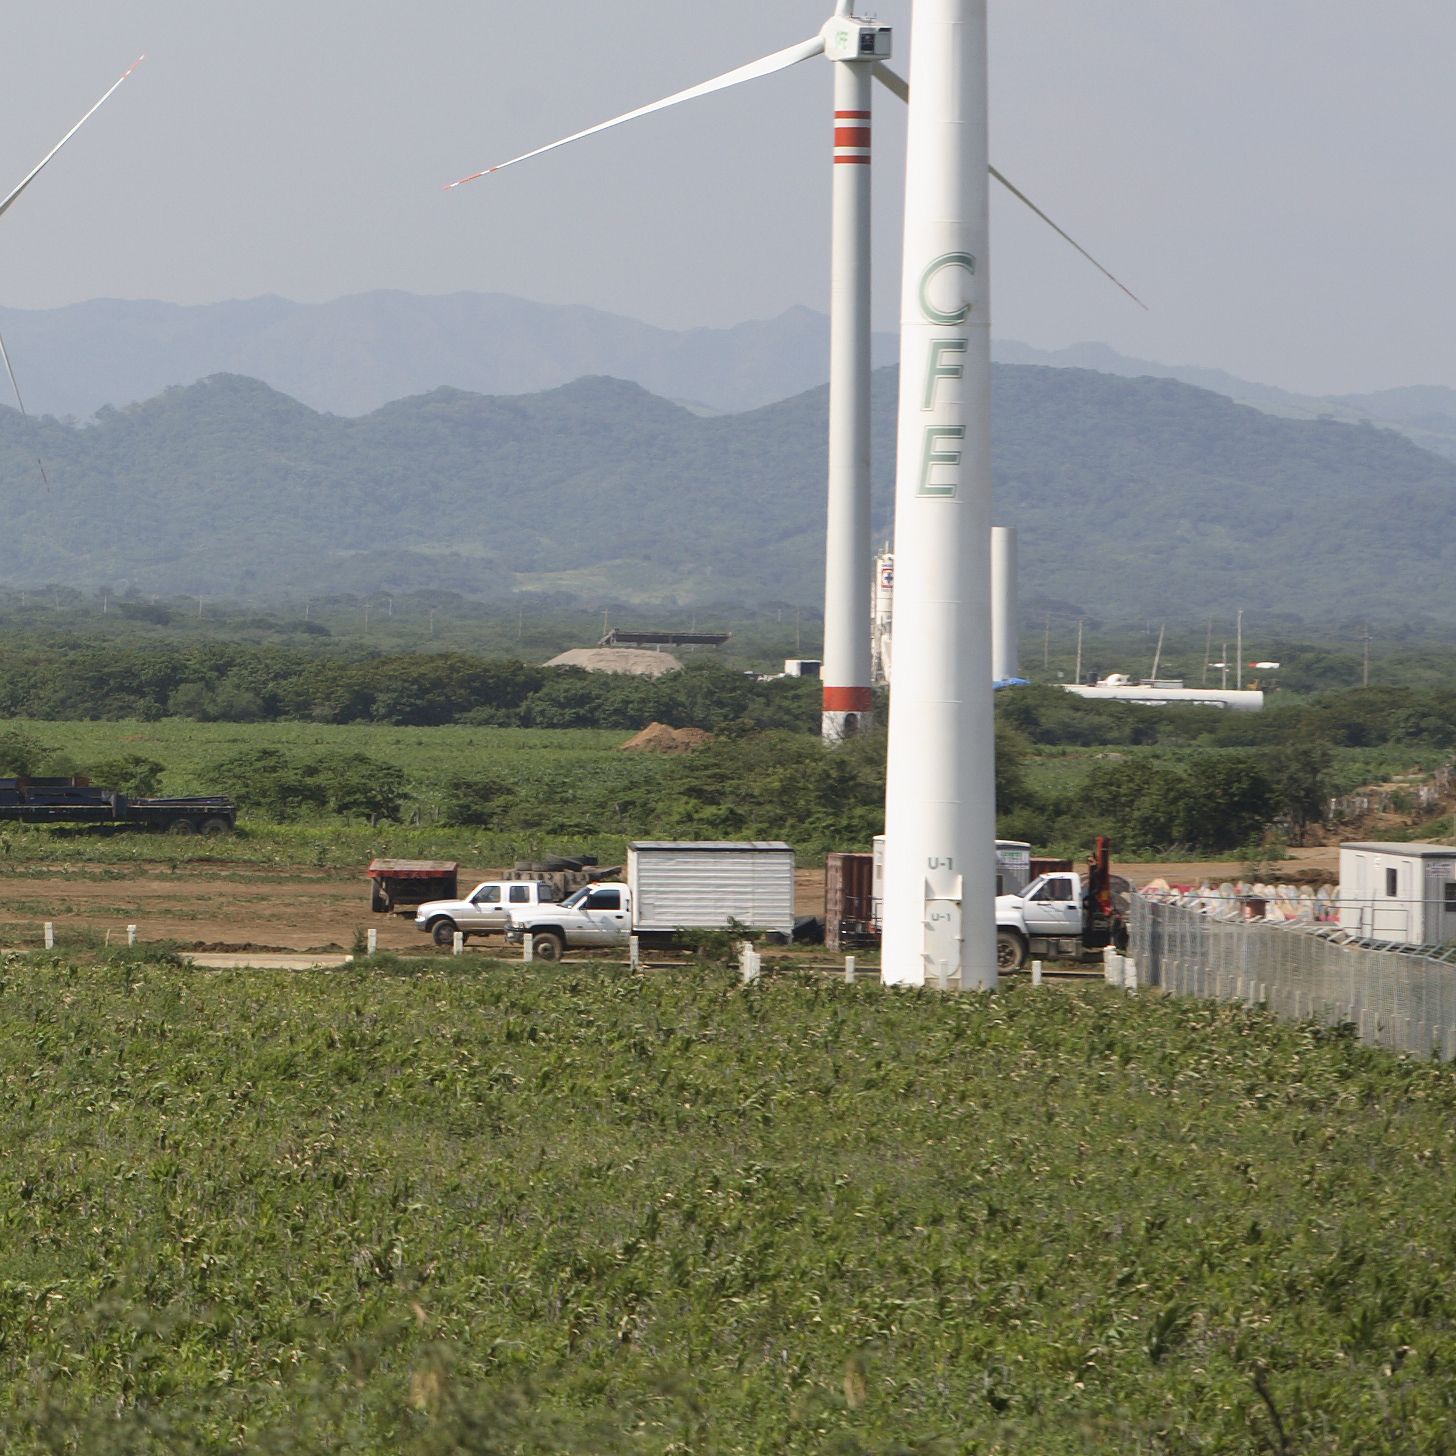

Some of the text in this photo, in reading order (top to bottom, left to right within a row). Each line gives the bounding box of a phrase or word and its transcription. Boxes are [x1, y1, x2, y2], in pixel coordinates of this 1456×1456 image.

[915, 251, 977, 499] CFE
[928, 857, 953, 870] U-1
[931, 912, 951, 921] U-1
